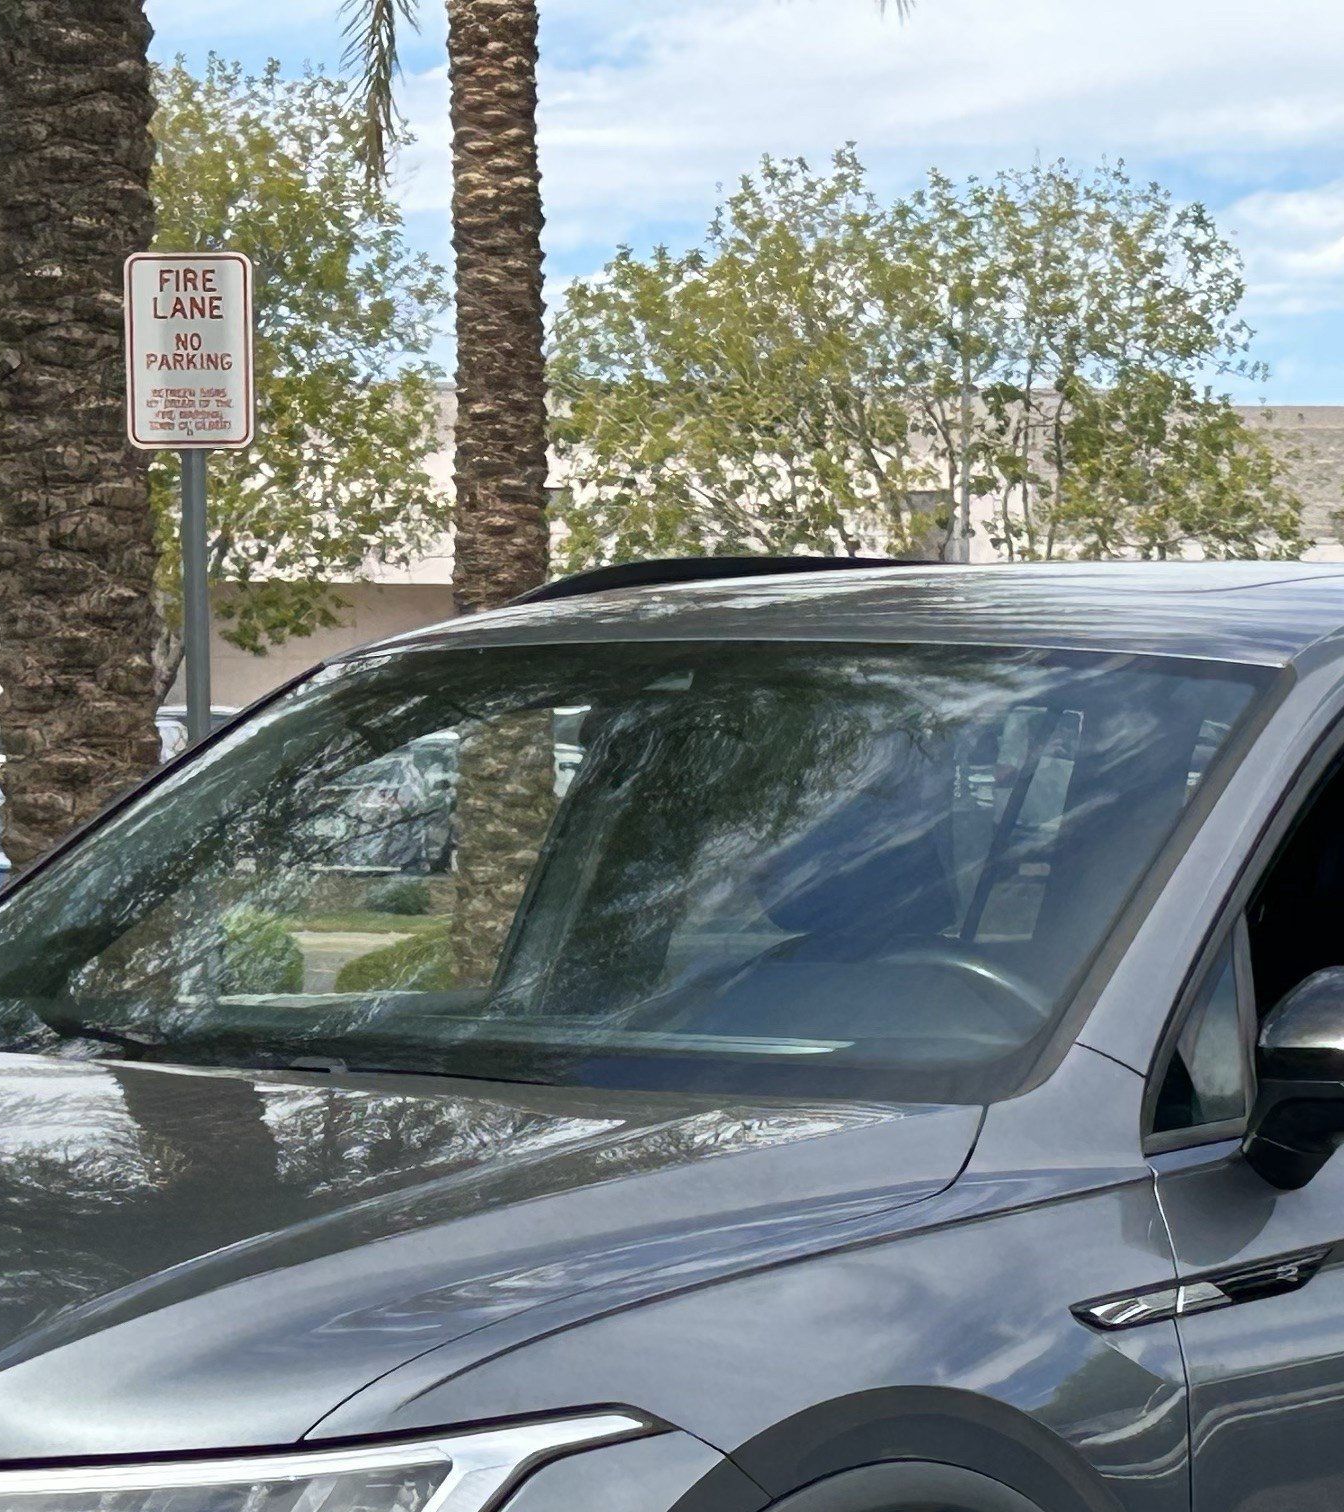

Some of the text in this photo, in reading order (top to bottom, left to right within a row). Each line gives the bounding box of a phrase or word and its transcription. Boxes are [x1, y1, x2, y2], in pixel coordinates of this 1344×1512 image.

[159, 269, 217, 293] FIRE
[152, 296, 224, 320] LANE
[174, 332, 202, 351] NO
[145, 353, 233, 371] PARKING
